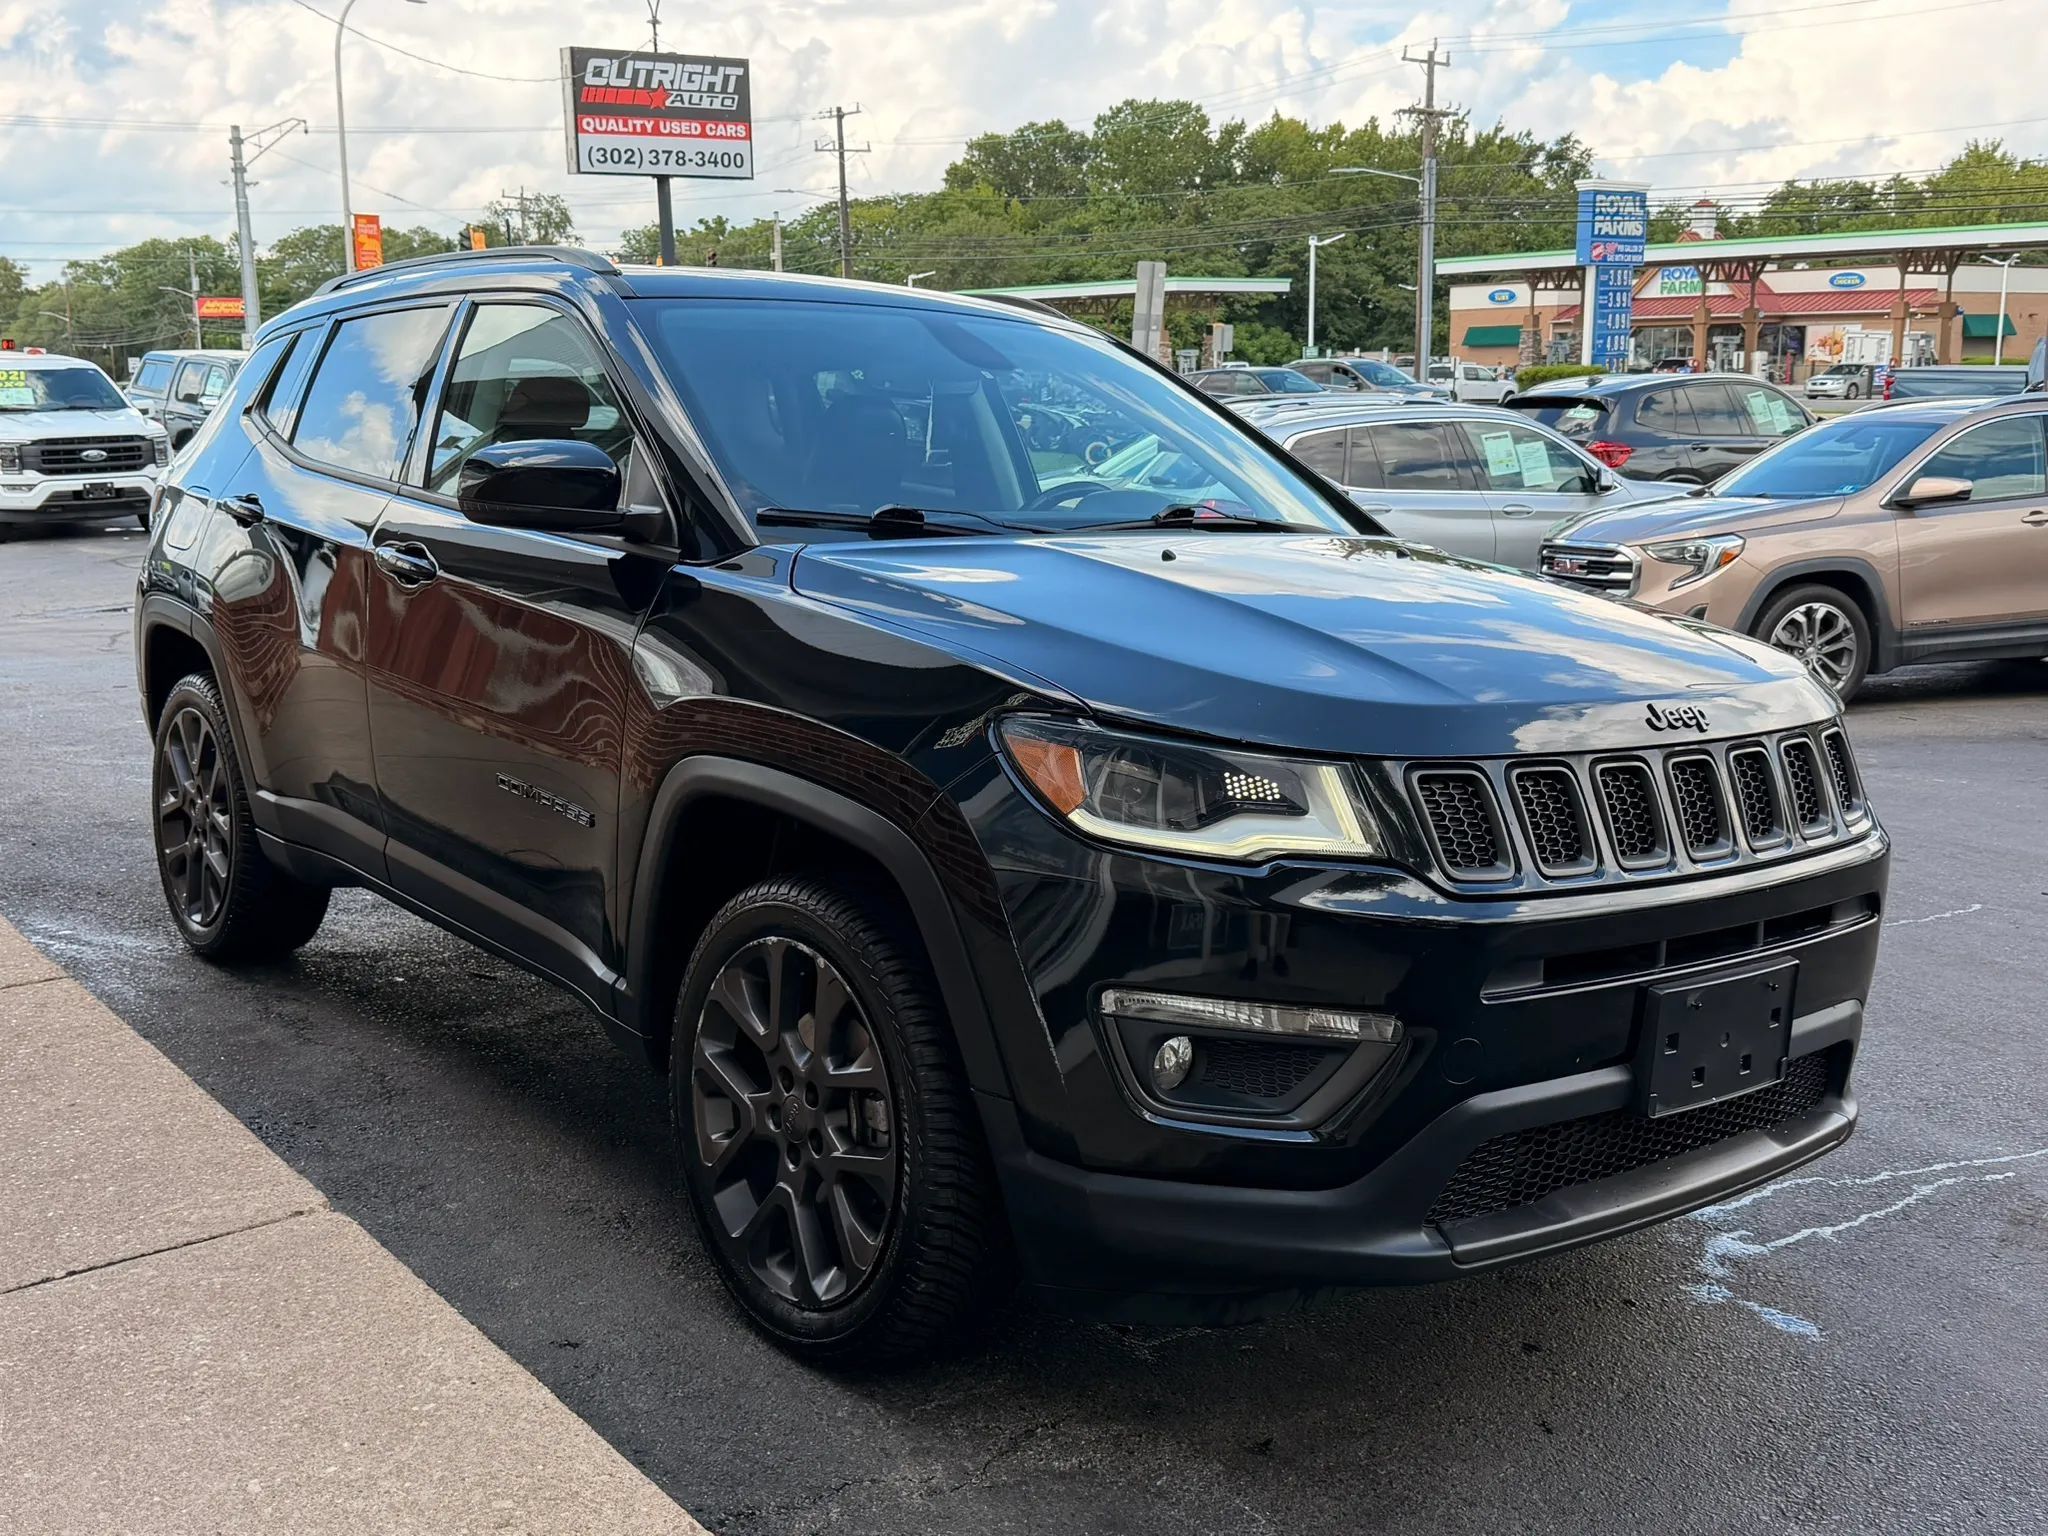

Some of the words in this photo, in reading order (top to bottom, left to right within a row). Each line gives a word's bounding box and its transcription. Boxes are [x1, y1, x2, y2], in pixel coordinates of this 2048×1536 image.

[584, 58, 744, 93] OUTRIGHT
[669, 92, 737, 109] AUTO
[582, 117, 654, 134] QUALITY
[659, 120, 701, 134] USED
[706, 122, 746, 137] CARS
[588, 146, 643, 168] (302)
[648, 150, 744, 168] 378-3400
[1595, 195, 1643, 215] ROYAL
[1594, 215, 1643, 236] FARMS
[1661, 268, 1698, 280] ROYA
[1660, 281, 1704, 295] FARM
[1645, 703, 1710, 733] Jeep
